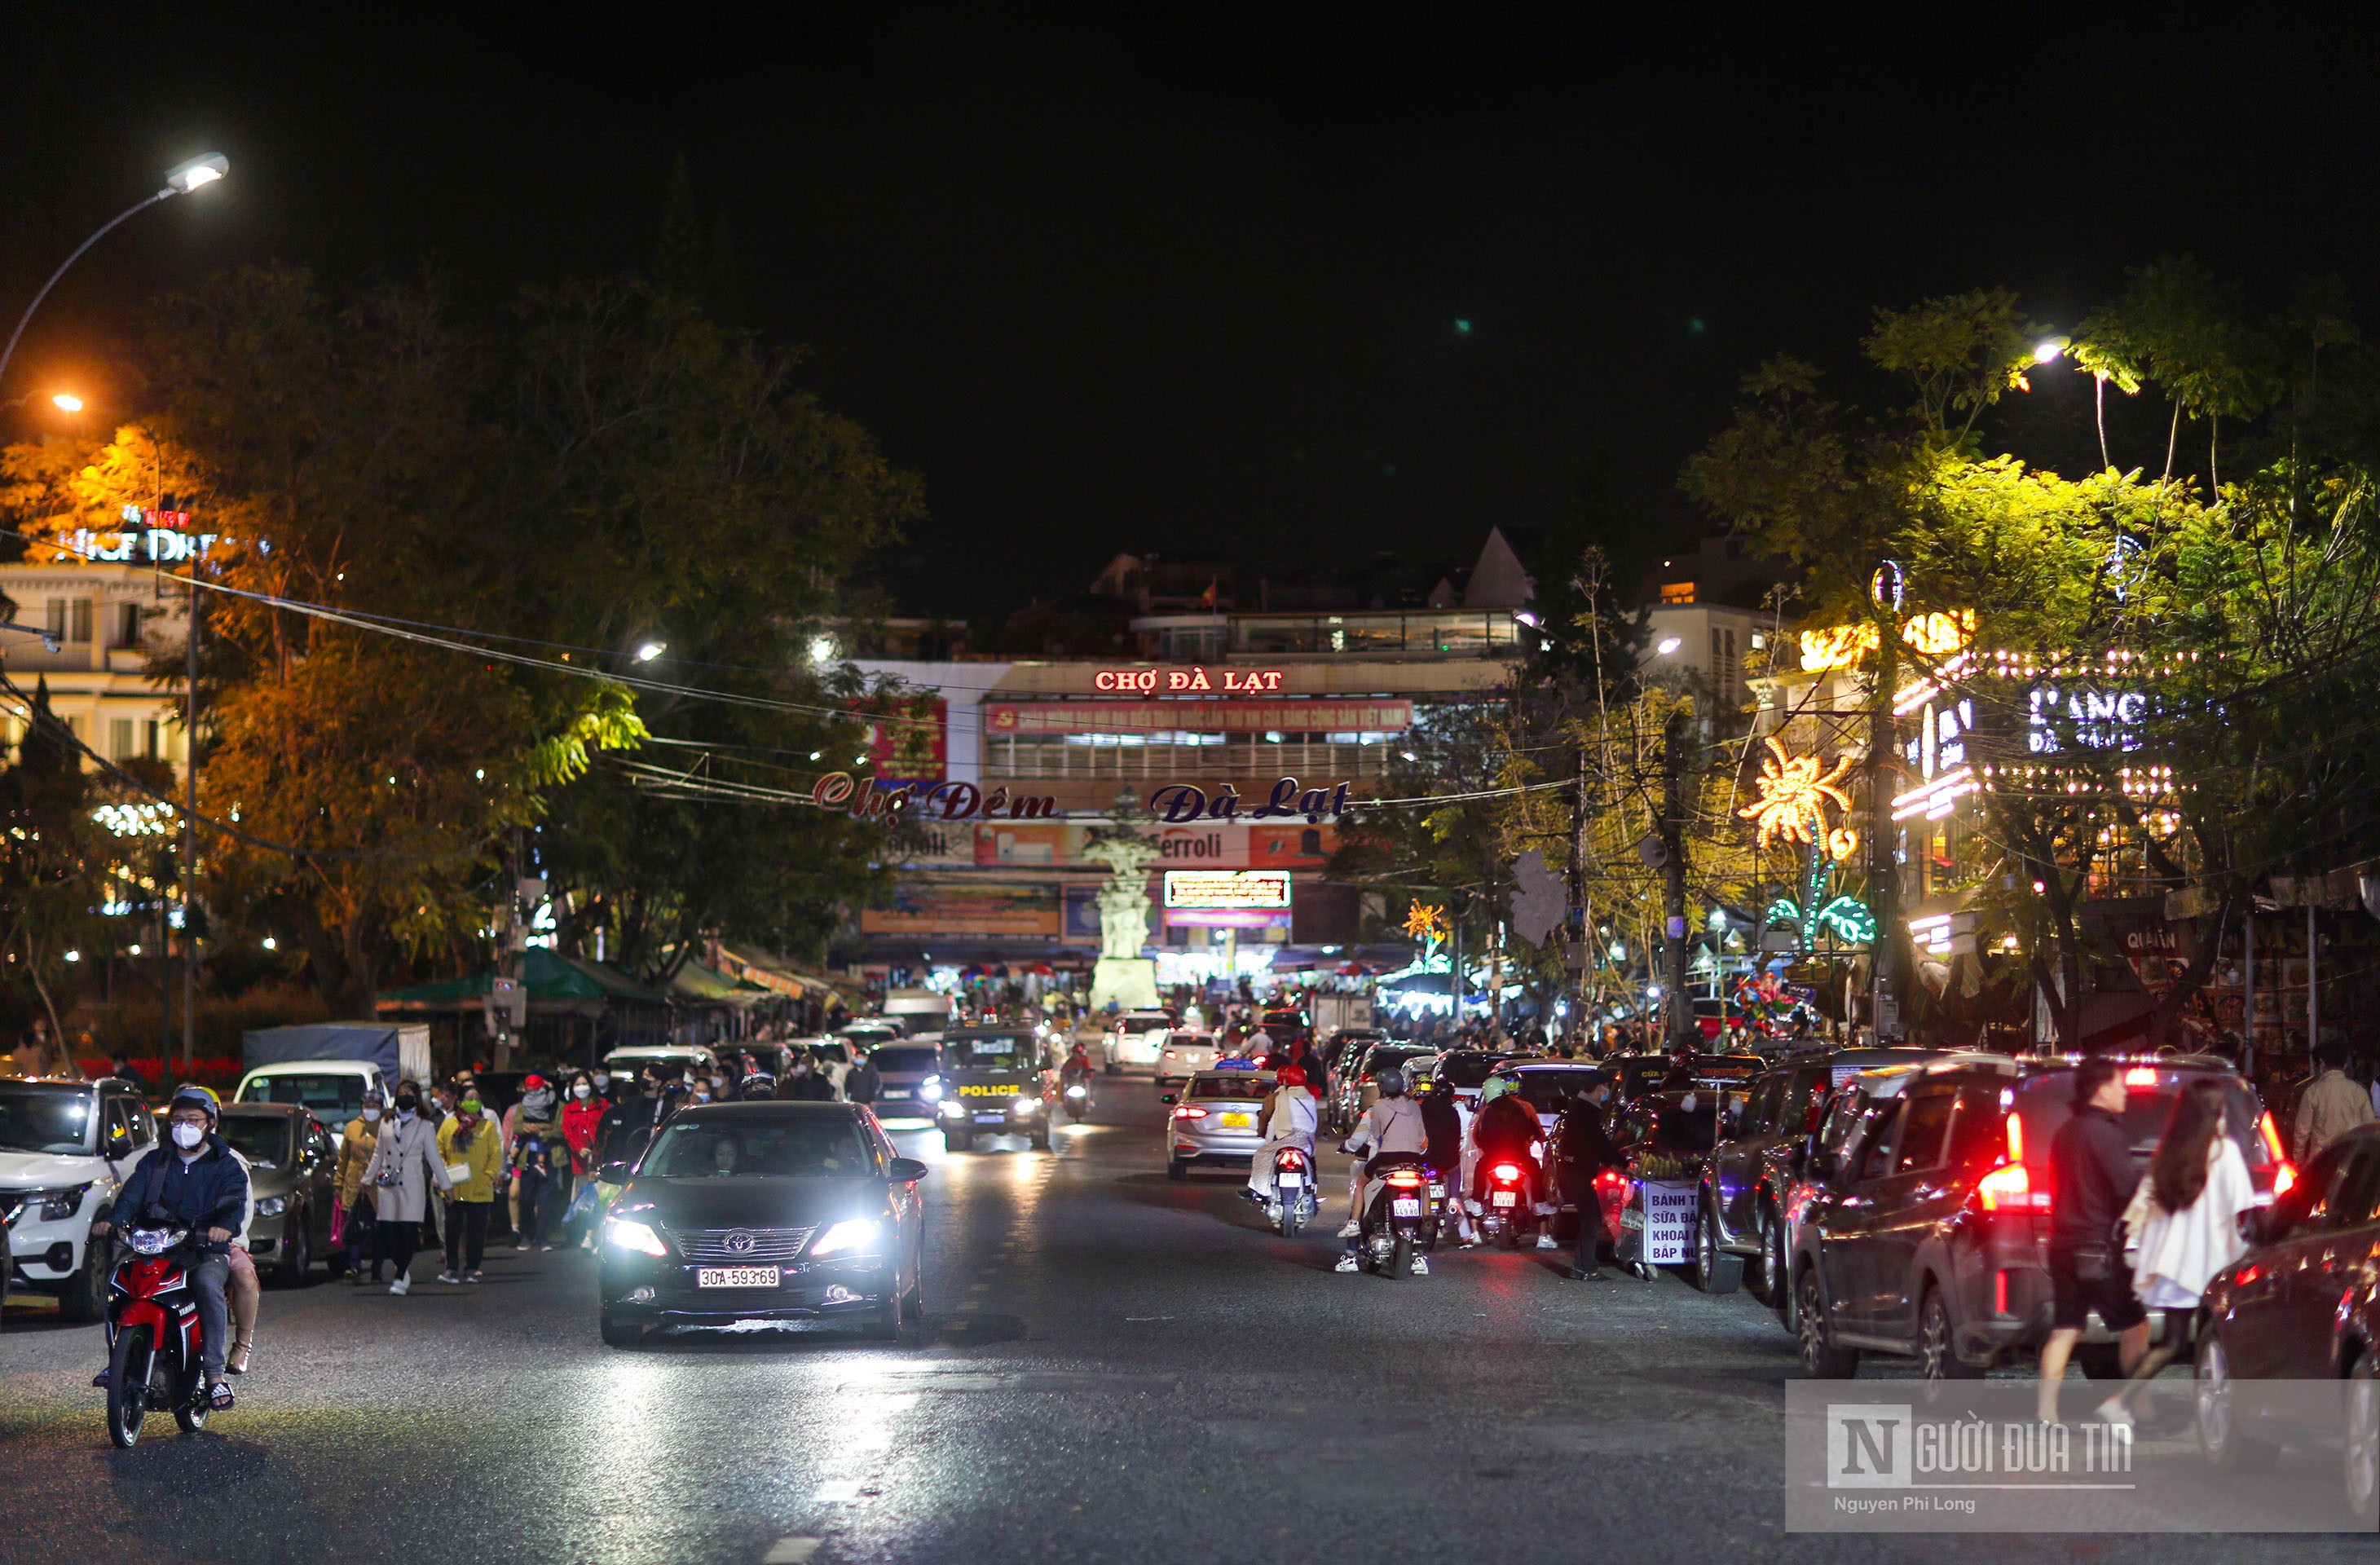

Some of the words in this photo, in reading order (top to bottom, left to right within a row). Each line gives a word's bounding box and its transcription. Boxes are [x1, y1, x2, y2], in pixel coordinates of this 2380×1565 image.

[1095, 668, 1157, 695] CHỢ
[1169, 666, 1211, 690] ĐÀ
[1224, 671, 1283, 695] LẠT
[813, 771, 916, 827] Chợ
[926, 782, 1060, 820] Đêm
[1150, 783, 1242, 823] Đà
[1253, 777, 1355, 824] Lạt
[959, 1085, 1020, 1096] POLICE
[1652, 1192, 1686, 1206] BÁNH
[1652, 1210, 1677, 1223] SỮA
[1681, 1210, 1696, 1226] ĐẬ
[1653, 1230, 1689, 1241] KHOAI
[702, 1270, 776, 1285] 30A-593.69
